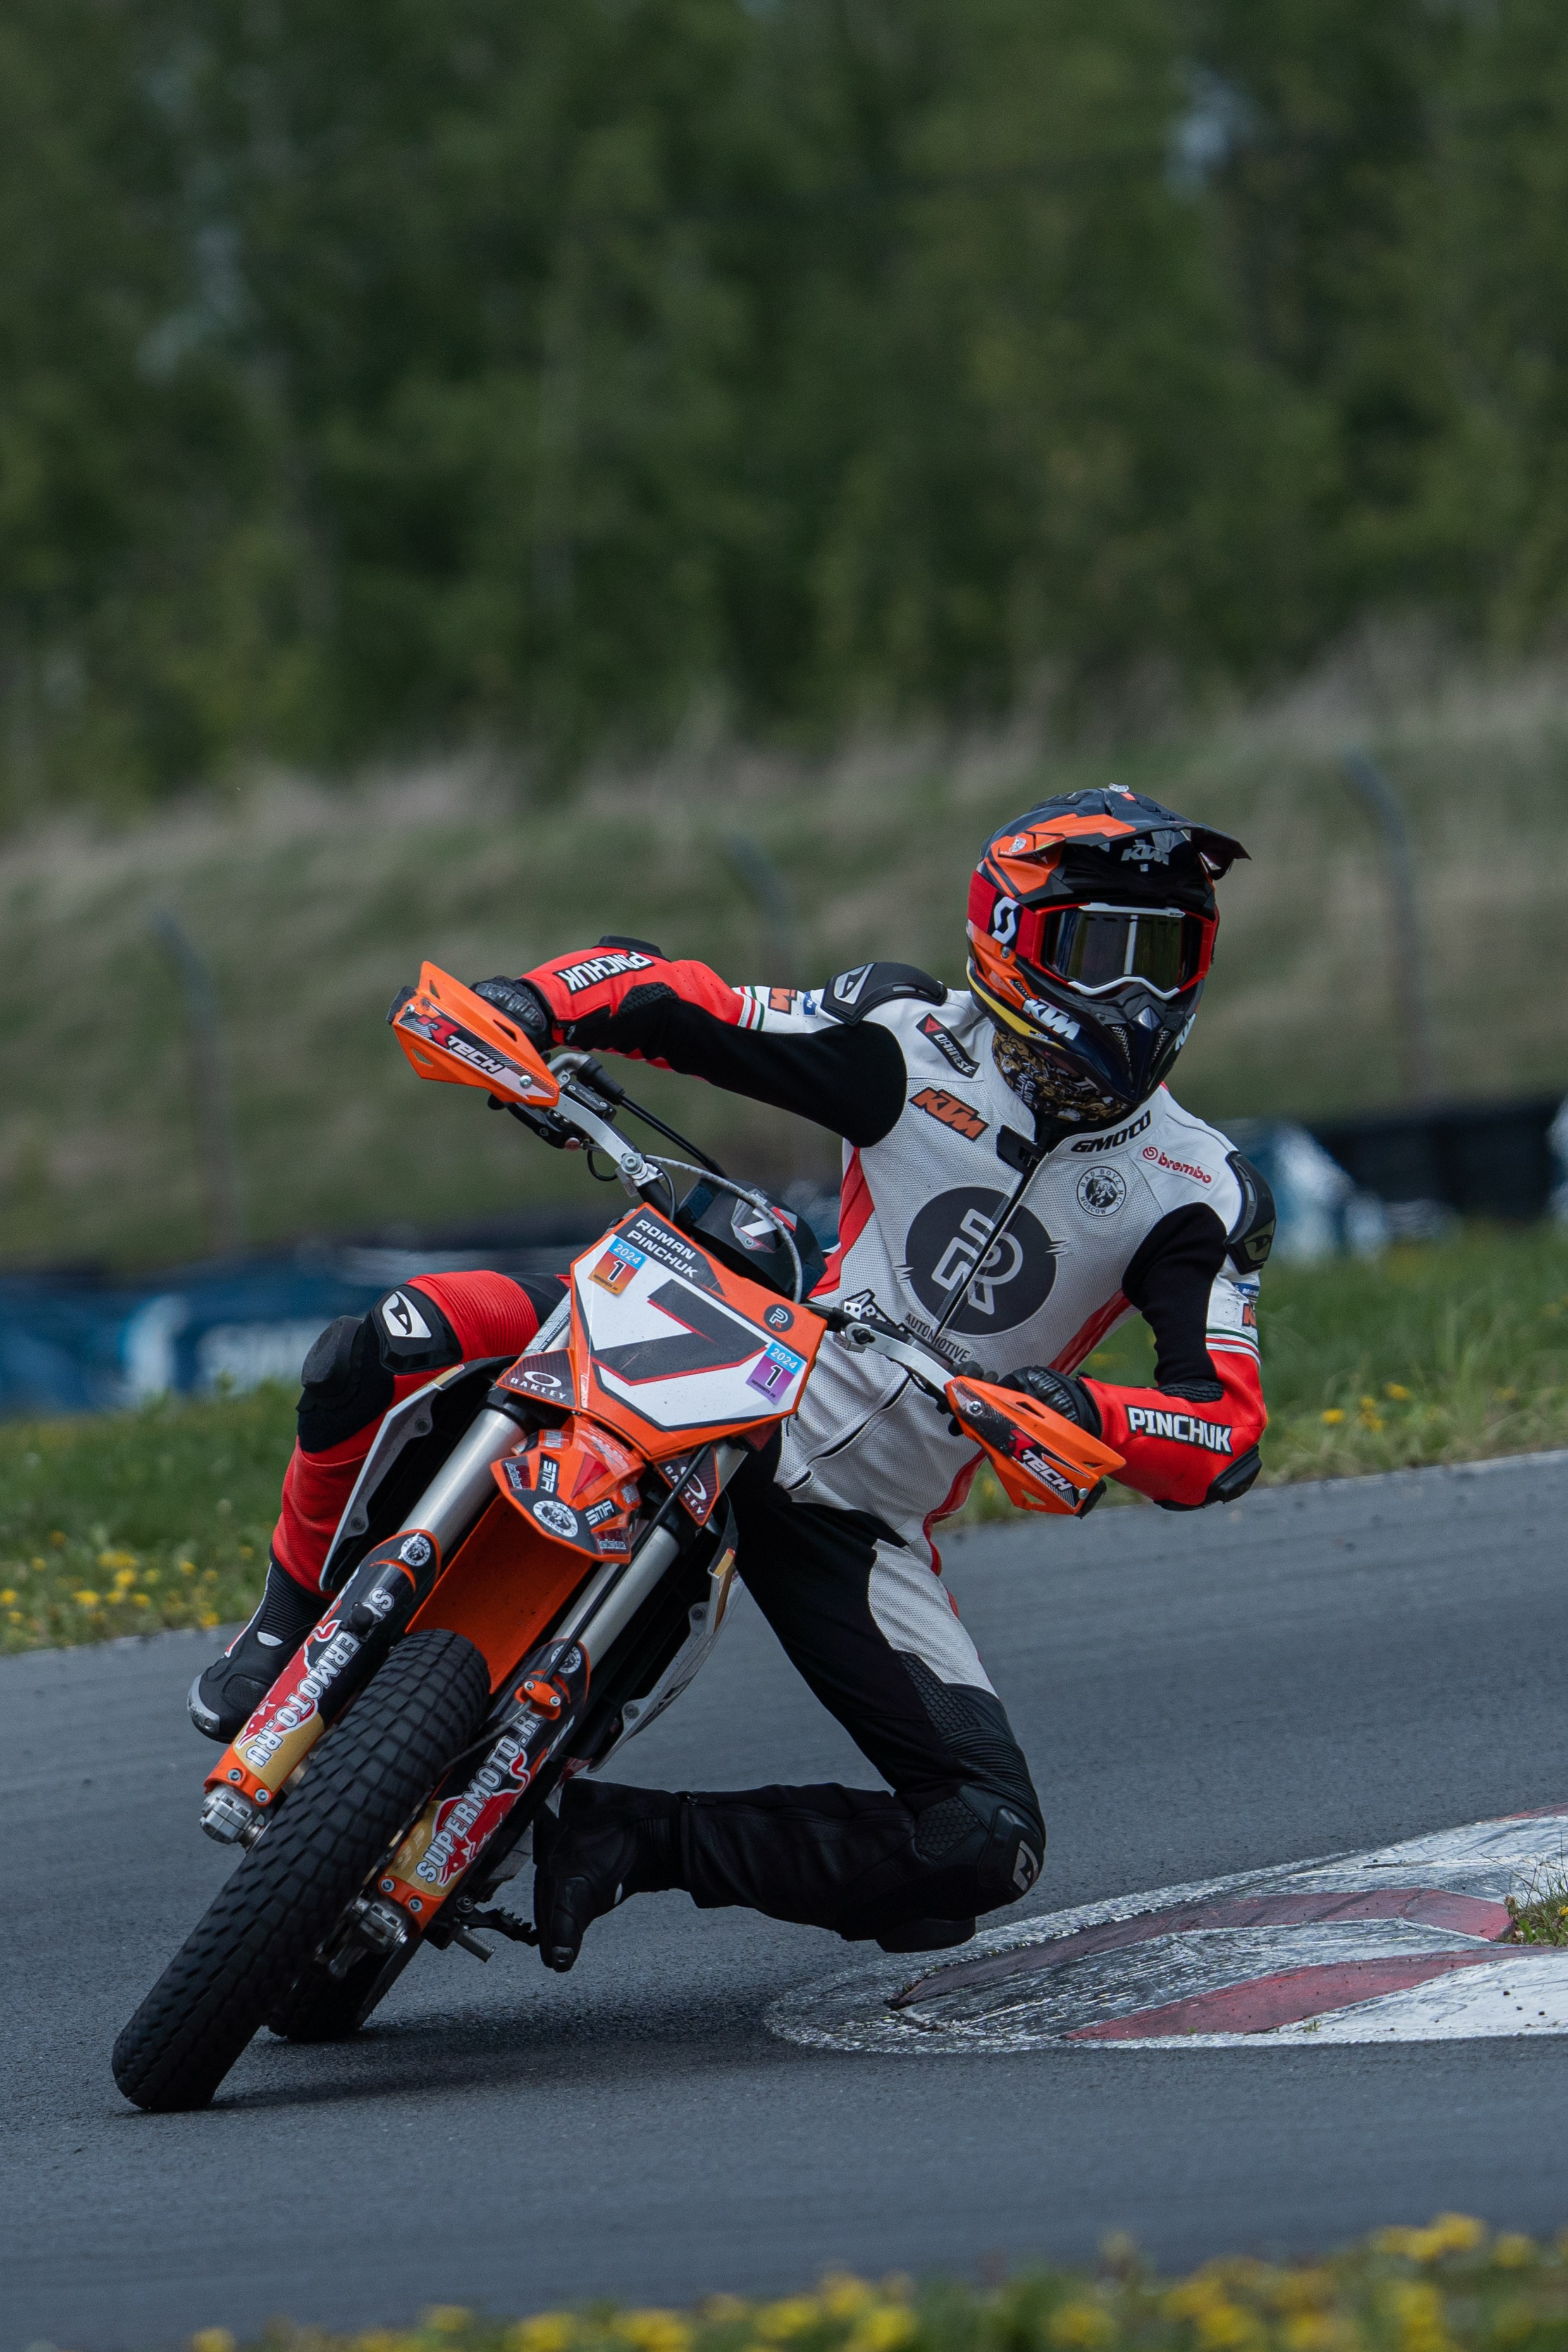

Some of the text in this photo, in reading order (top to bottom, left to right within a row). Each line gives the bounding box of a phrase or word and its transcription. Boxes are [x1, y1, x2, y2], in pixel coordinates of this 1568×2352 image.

[557, 951, 653, 991] PINCHUK
[1022, 998, 1080, 1040] KTM
[911, 1087, 987, 1139] KTM
[1080, 1171, 1095, 1187] BAD
[1080, 1196, 1107, 1214] MOSCOW
[614, 1244, 642, 1265] 2024
[627, 1230, 699, 1278] PINCHUK
[635, 1219, 696, 1260] ROMAN
[608, 1260, 627, 1282] 1
[592, 1278, 768, 1385] 7
[765, 1365, 783, 1387] 1
[770, 1347, 798, 1369] 2024
[510, 1377, 567, 1399] OAKLEY
[1127, 1407, 1232, 1452] PINCHUK
[665, 1465, 704, 1514] OALEY
